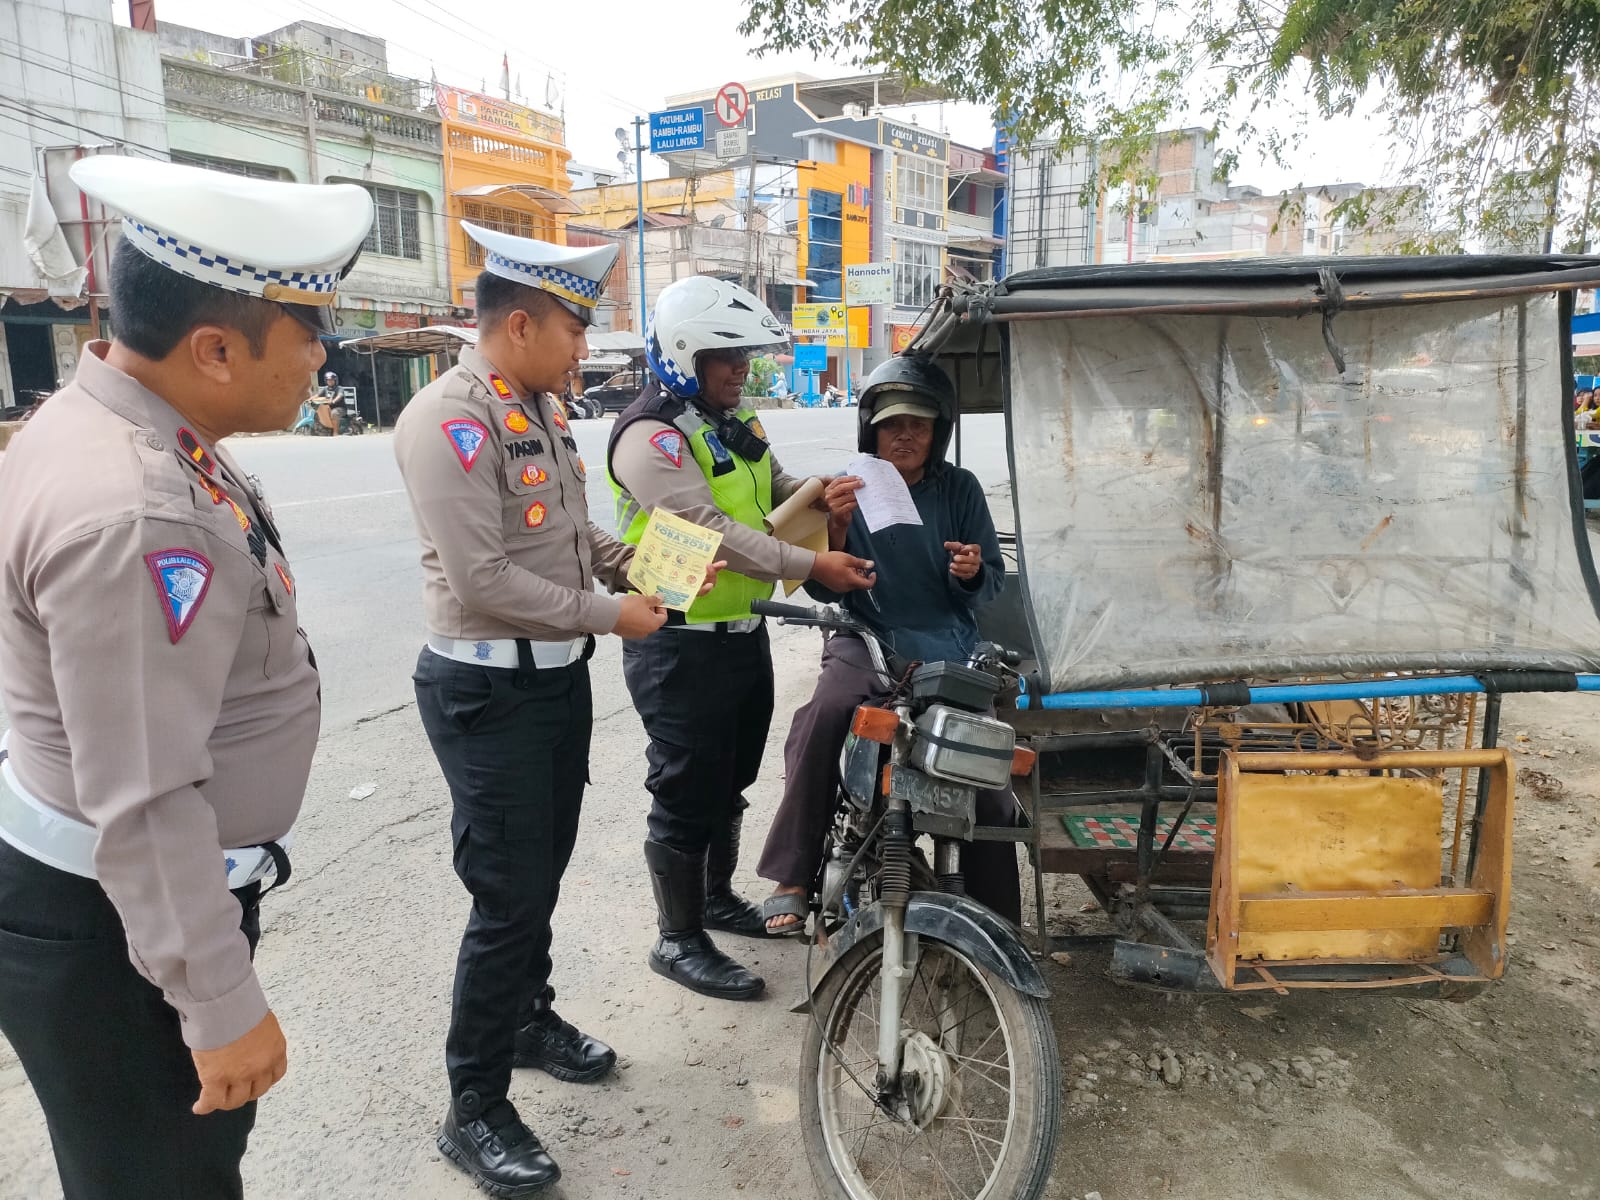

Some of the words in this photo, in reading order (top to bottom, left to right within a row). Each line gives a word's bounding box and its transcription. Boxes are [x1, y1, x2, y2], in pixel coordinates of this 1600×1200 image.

[755, 88, 782, 102] RELASI
[480, 105, 514, 119] PARTAI
[659, 112, 695, 125] PATUHILAH
[480, 113, 521, 129] HANURA
[652, 123, 702, 138] RAMBU-RAMBU
[656, 140, 675, 149] LALU
[675, 137, 698, 147] LINTAS
